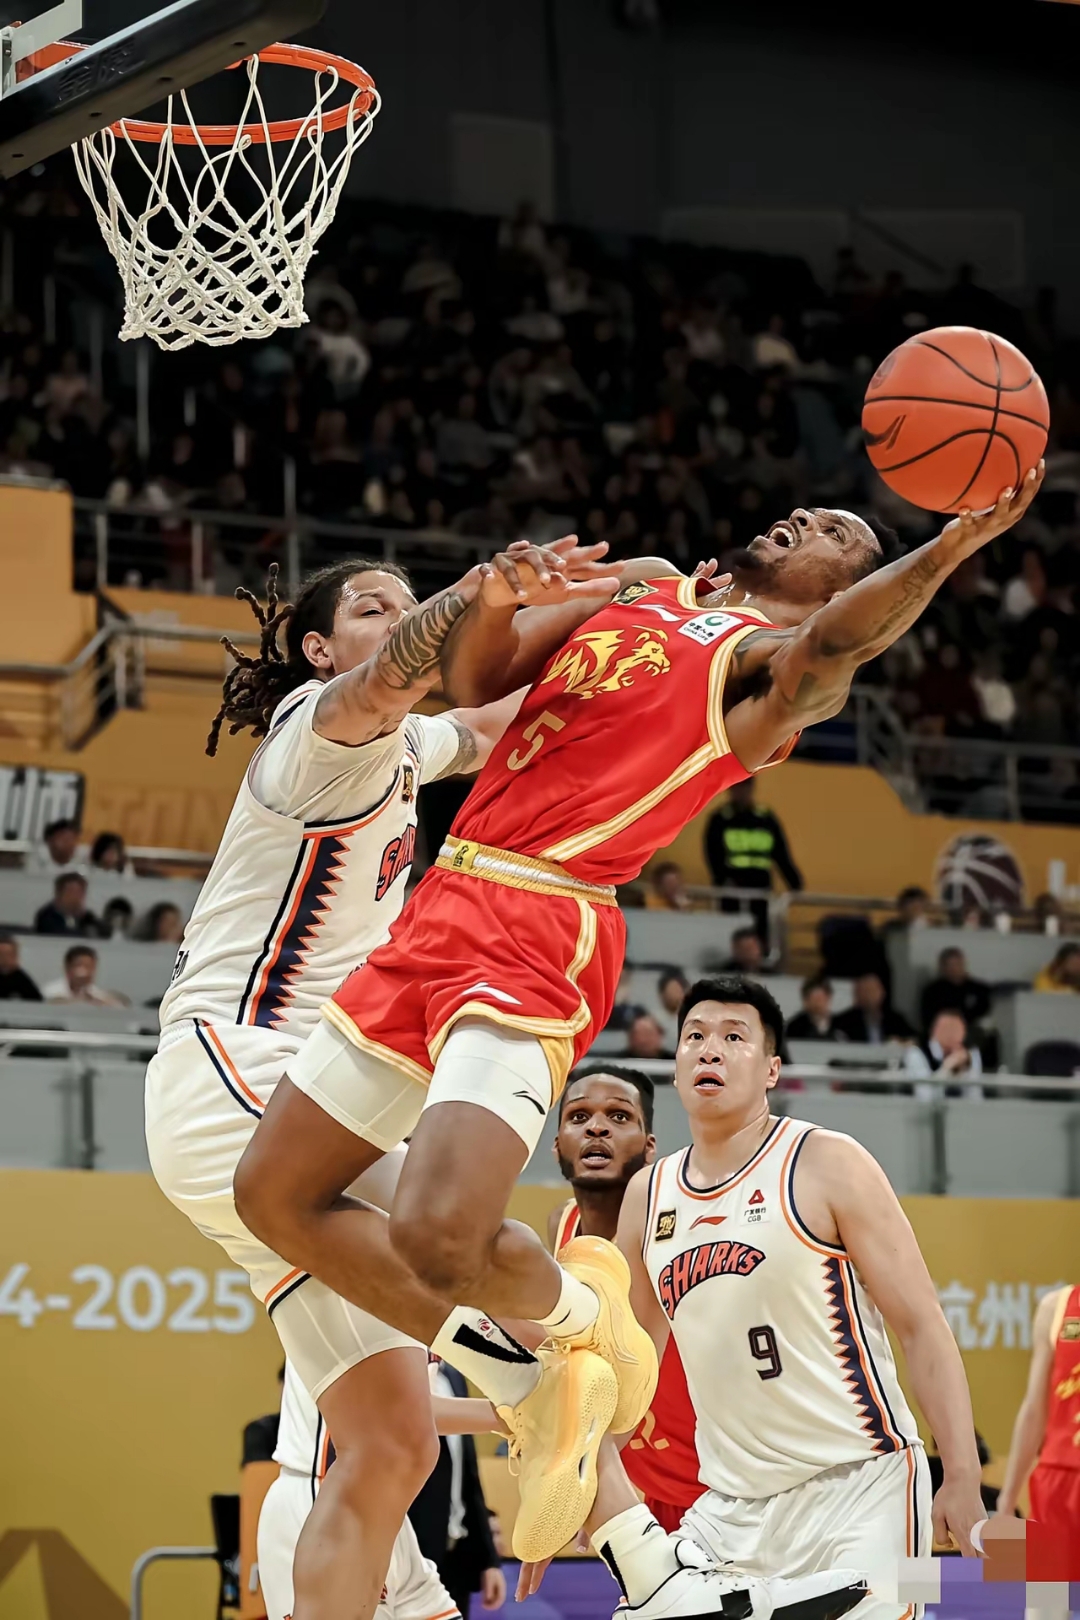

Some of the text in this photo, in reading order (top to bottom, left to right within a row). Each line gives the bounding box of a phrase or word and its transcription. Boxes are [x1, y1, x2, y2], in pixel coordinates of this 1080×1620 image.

[507, 710, 566, 771] 5
[658, 1241, 766, 1320] SHARKS
[747, 1324, 783, 1380] 9
